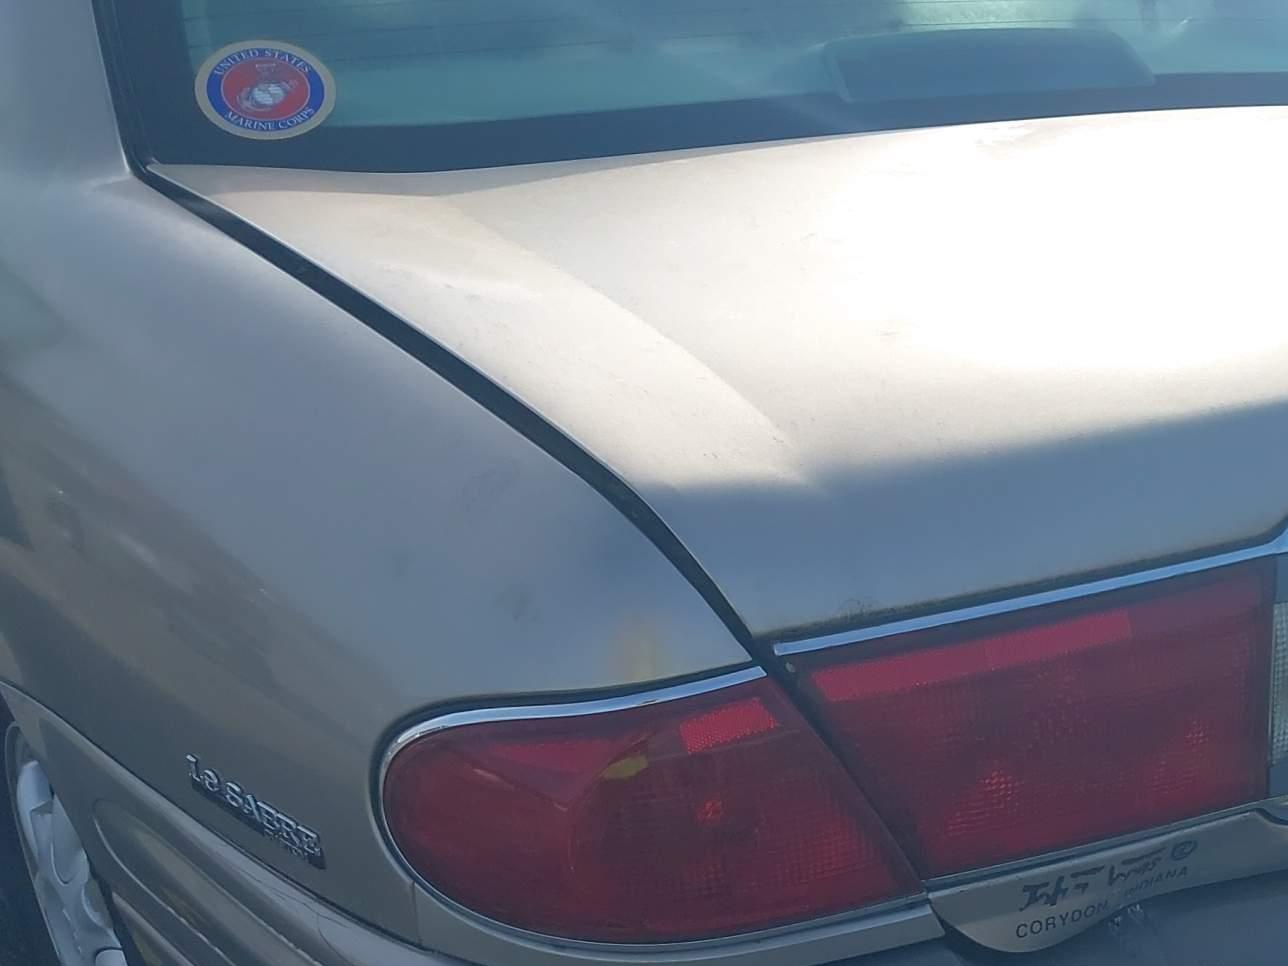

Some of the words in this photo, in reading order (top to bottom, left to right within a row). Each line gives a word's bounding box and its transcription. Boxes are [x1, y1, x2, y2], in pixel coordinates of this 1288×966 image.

[214, 49, 259, 76] UNITED
[264, 49, 312, 73] STATES
[225, 111, 275, 131] MARINE
[278, 107, 315, 129] CORPS
